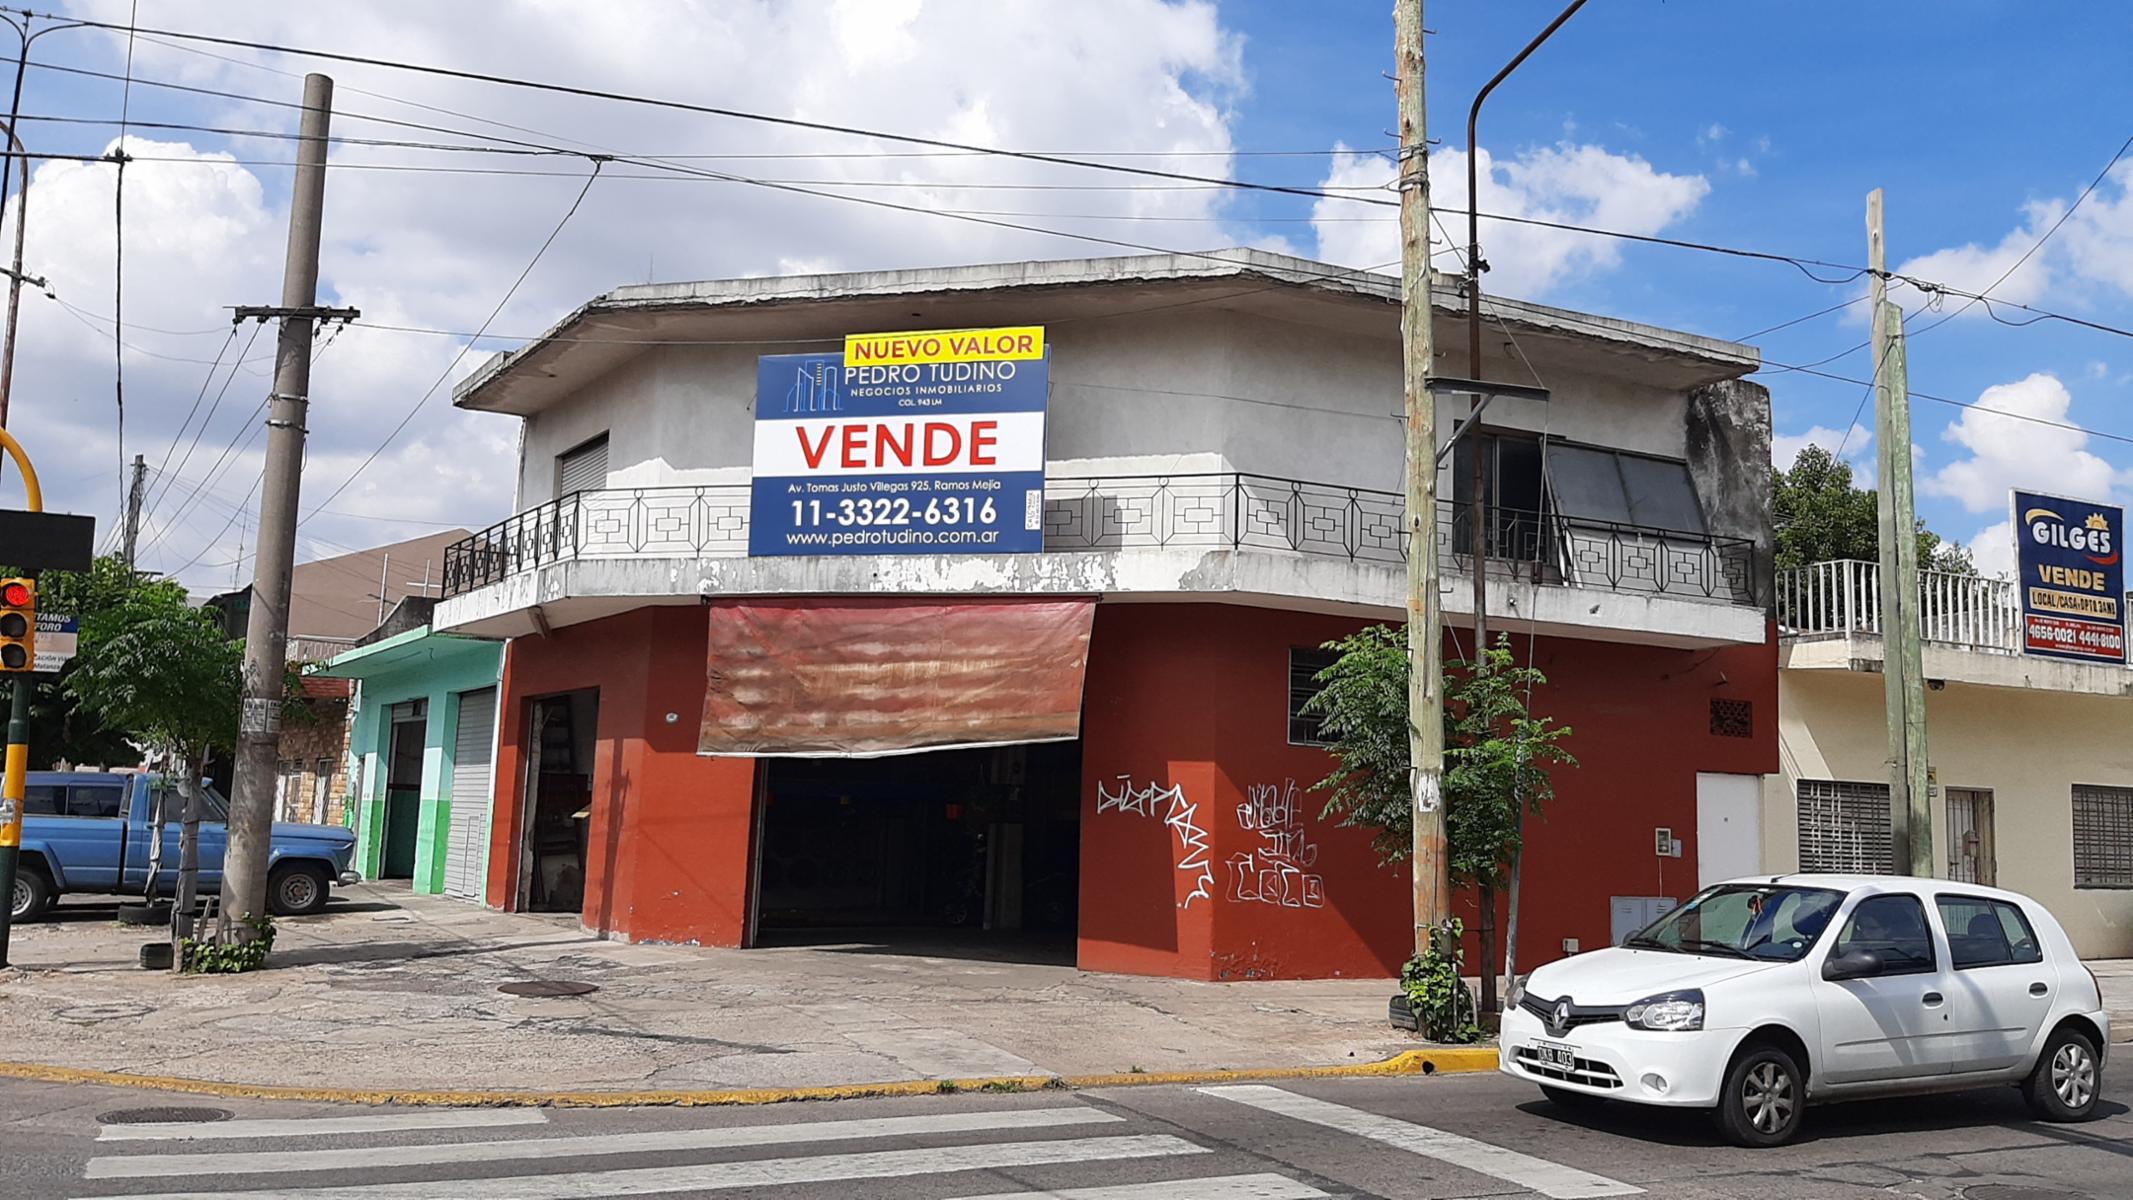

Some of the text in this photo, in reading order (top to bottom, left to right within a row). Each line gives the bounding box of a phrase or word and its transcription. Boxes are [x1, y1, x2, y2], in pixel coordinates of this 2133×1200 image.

[855, 335, 1033, 360] NUEVO VALOR
[845, 361, 1016, 385] PEDRO TUDINO
[850, 383, 1003, 397] NEGOCIOS INMOBILIARIOS
[795, 420, 998, 469] VENDE
[788, 484, 804, 493] Av.
[806, 483, 839, 493] Tomas
[841, 482, 867, 493] Justo
[870, 481, 909, 493] Villegas
[934, 479, 970, 491] Ramos
[791, 497, 997, 526] 11-3322-6316
[786, 529, 999, 547] www.pedrotudino.com.ar
[2032, 521, 2111, 554] GILGES
[2038, 564, 2104, 591] VENDE
[2029, 623, 2077, 644] 4656-0021
[2078, 630, 2121, 649] 4441-8100
